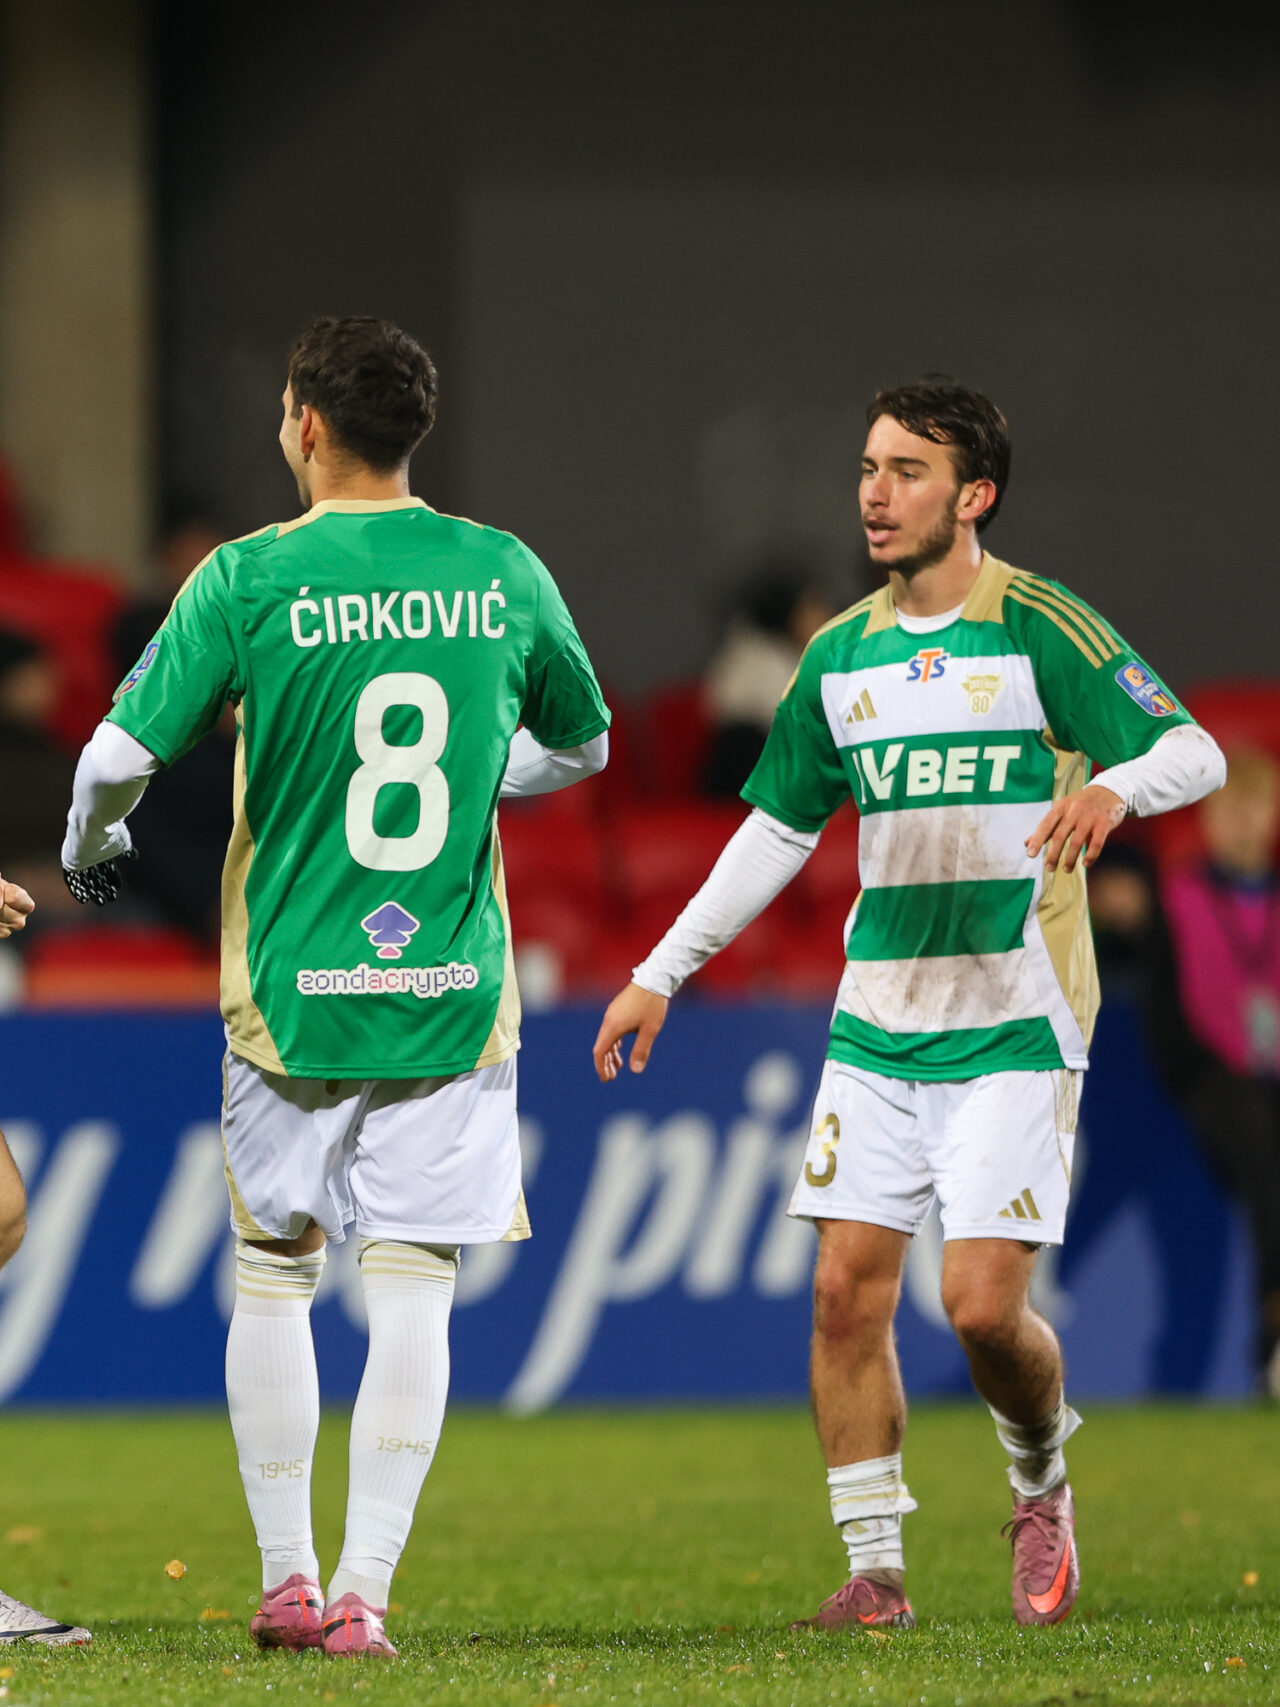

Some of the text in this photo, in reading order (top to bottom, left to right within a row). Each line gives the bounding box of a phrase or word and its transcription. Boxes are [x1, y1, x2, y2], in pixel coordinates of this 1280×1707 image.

[289, 579, 507, 648] ĆIRKOVIĆ
[906, 650, 949, 683] STS
[971, 695, 990, 714] 80
[345, 672, 450, 871] 8
[300, 965, 477, 996] zondacrypto
[805, 1113, 841, 1188] 3
[376, 1436, 433, 1456] 1945
[258, 1459, 305, 1480] 1945
